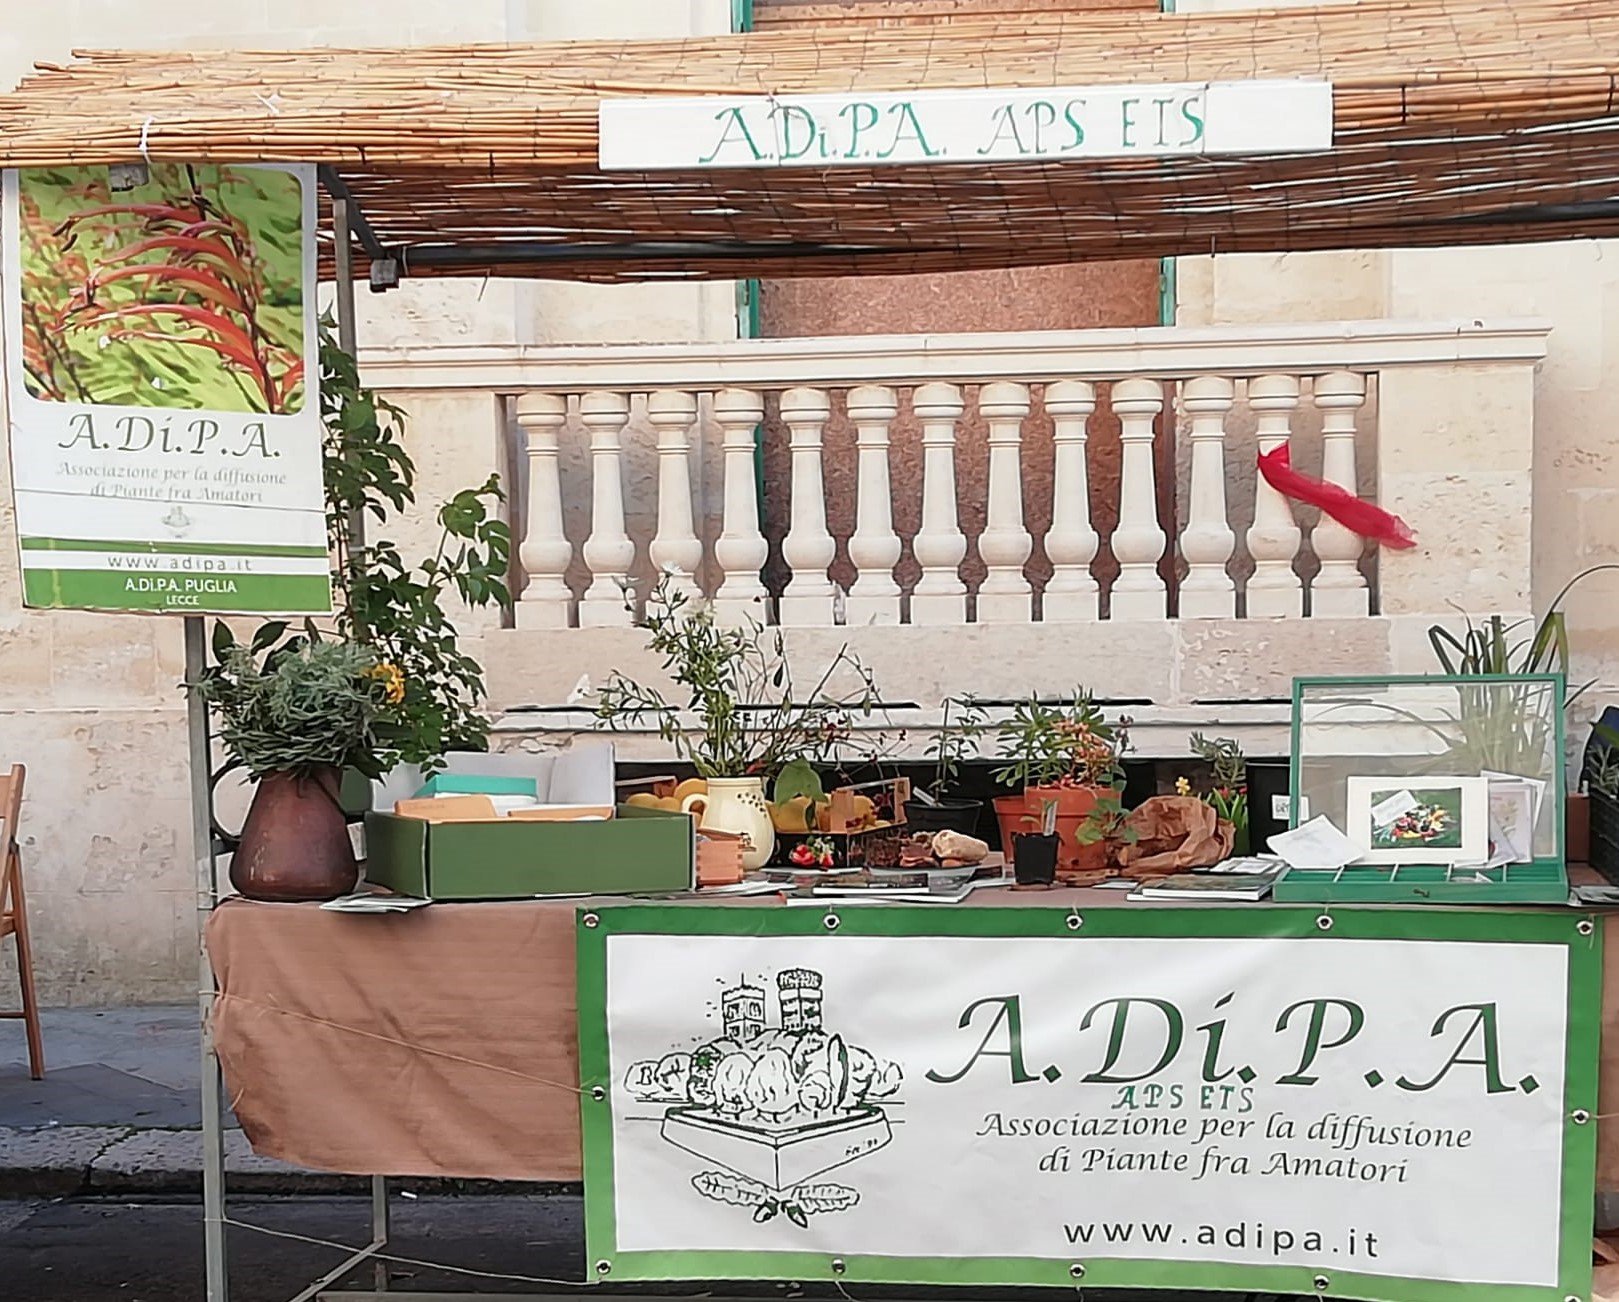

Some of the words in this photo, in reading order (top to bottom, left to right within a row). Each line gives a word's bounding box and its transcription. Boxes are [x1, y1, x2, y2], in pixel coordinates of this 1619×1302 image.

[977, 99, 1087, 155] APS
[1122, 97, 1206, 149] ETS
[56, 462, 158, 481] Associazione
[163, 468, 188, 484] per
[194, 465, 209, 482] la
[213, 468, 287, 487] diffusione
[90, 480, 106, 498] di
[111, 483, 163, 500] Piante
[167, 484, 192, 502] fra
[197, 487, 263, 503] Amatori
[107, 555, 253, 573] www.adipa.it
[185, 579, 238, 594] PUGLIA
[166, 595, 200, 606] LECCE
[1111, 1084, 1184, 1111] APS
[1200, 1084, 1255, 1112] ETS
[975, 1112, 1188, 1139] Associazione
[1191, 1118, 1257, 1145] per
[1264, 1112, 1297, 1140] la
[1306, 1114, 1473, 1150] diffusione
[1037, 1146, 1071, 1174] di
[1080, 1147, 1189, 1173] Piante
[1190, 1149, 1250, 1180] fra
[1260, 1152, 1409, 1183] Amatori
[1063, 1222, 1380, 1258] www.adipa.it
